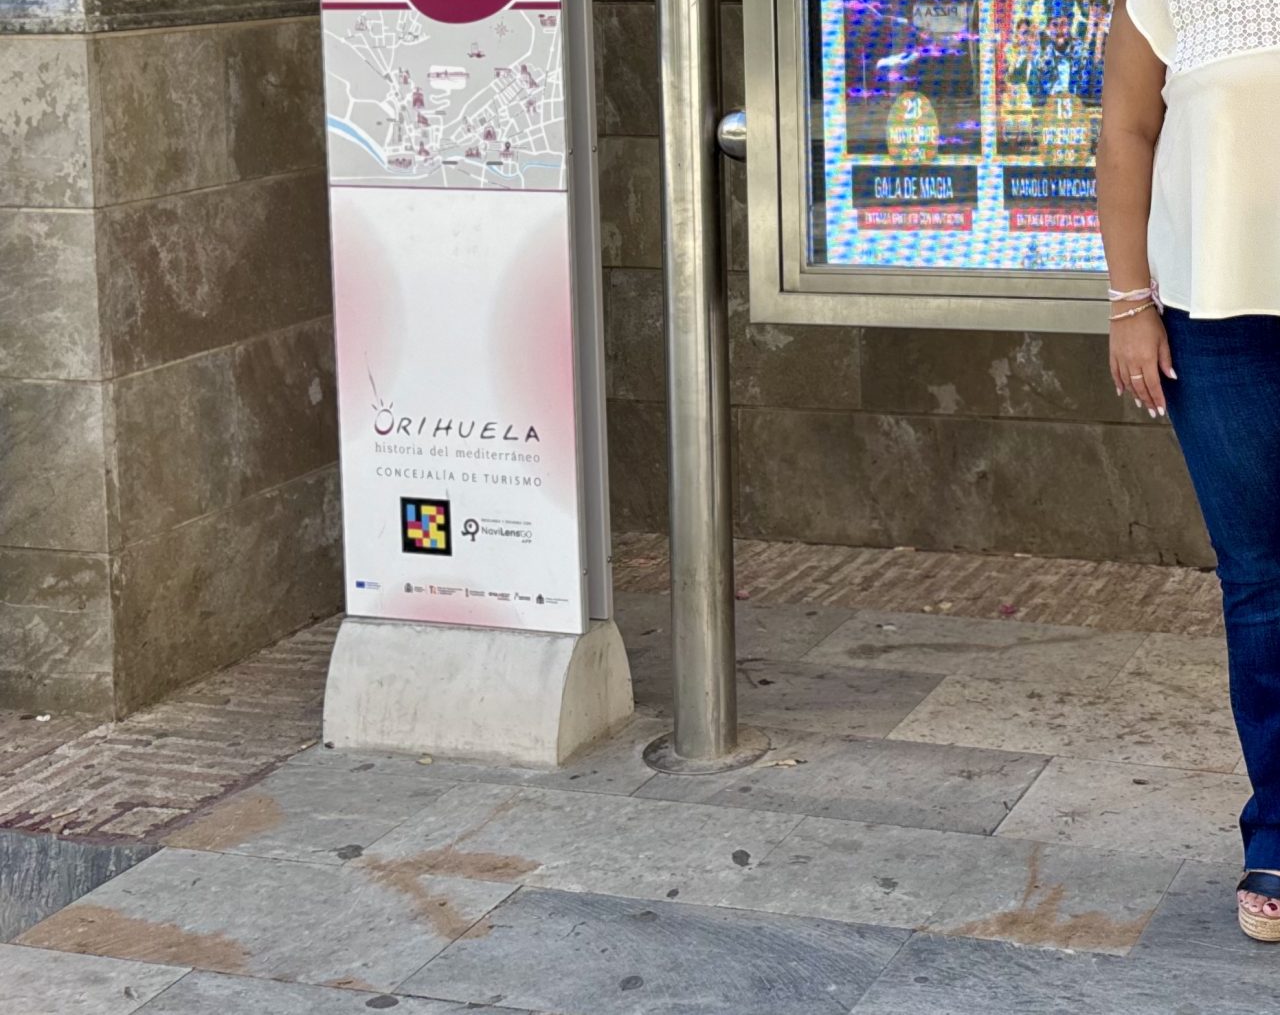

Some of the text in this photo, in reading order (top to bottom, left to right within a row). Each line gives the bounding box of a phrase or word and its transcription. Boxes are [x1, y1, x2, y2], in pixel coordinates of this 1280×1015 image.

[875, 176, 954, 199] GALA DE MAGIA
[374, 408, 540, 442] ORIHUELA
[375, 442, 540, 463] historia del mediterráneo
[376, 466, 542, 487] CONCEJALÍA DE TURISMO
